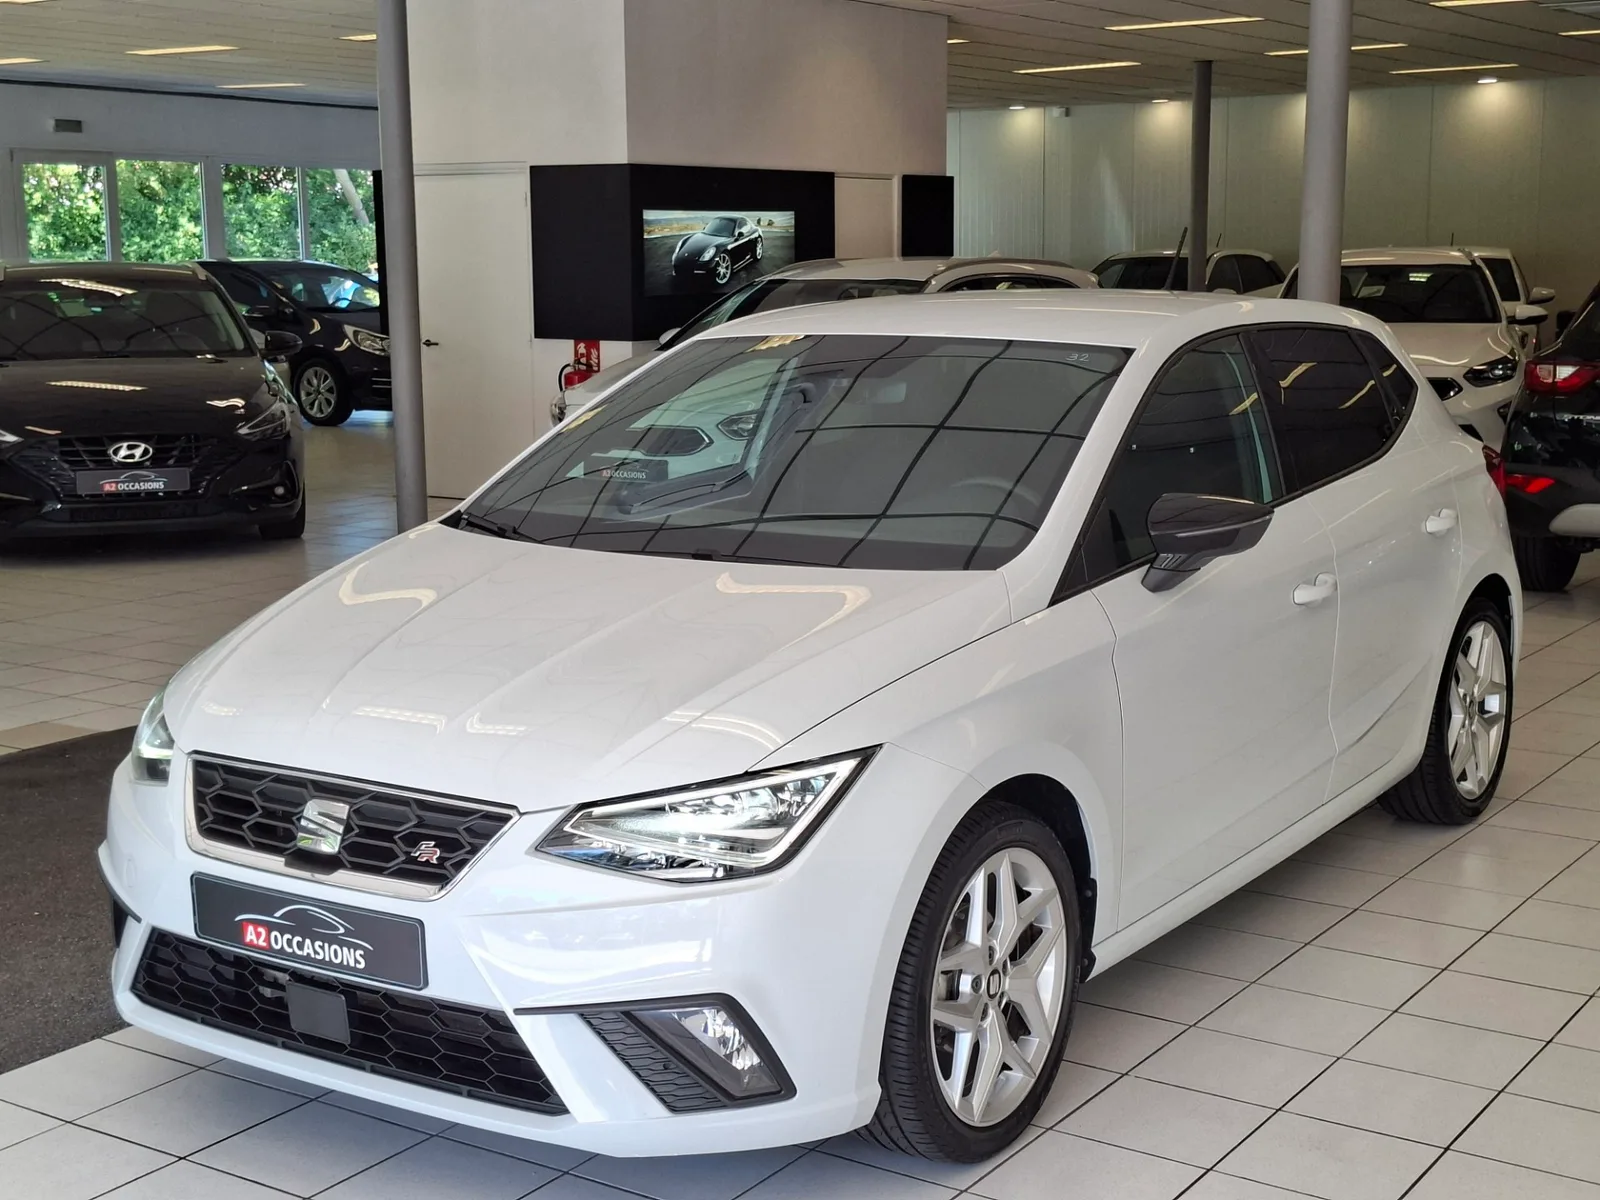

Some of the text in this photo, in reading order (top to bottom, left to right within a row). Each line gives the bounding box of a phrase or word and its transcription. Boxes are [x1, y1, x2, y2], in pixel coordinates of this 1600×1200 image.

[611, 469, 646, 479] OCCASIONS
[104, 481, 165, 492] A2 OCCASIONS
[411, 841, 441, 864] FR
[245, 924, 366, 970] A2 OCCASIONS
